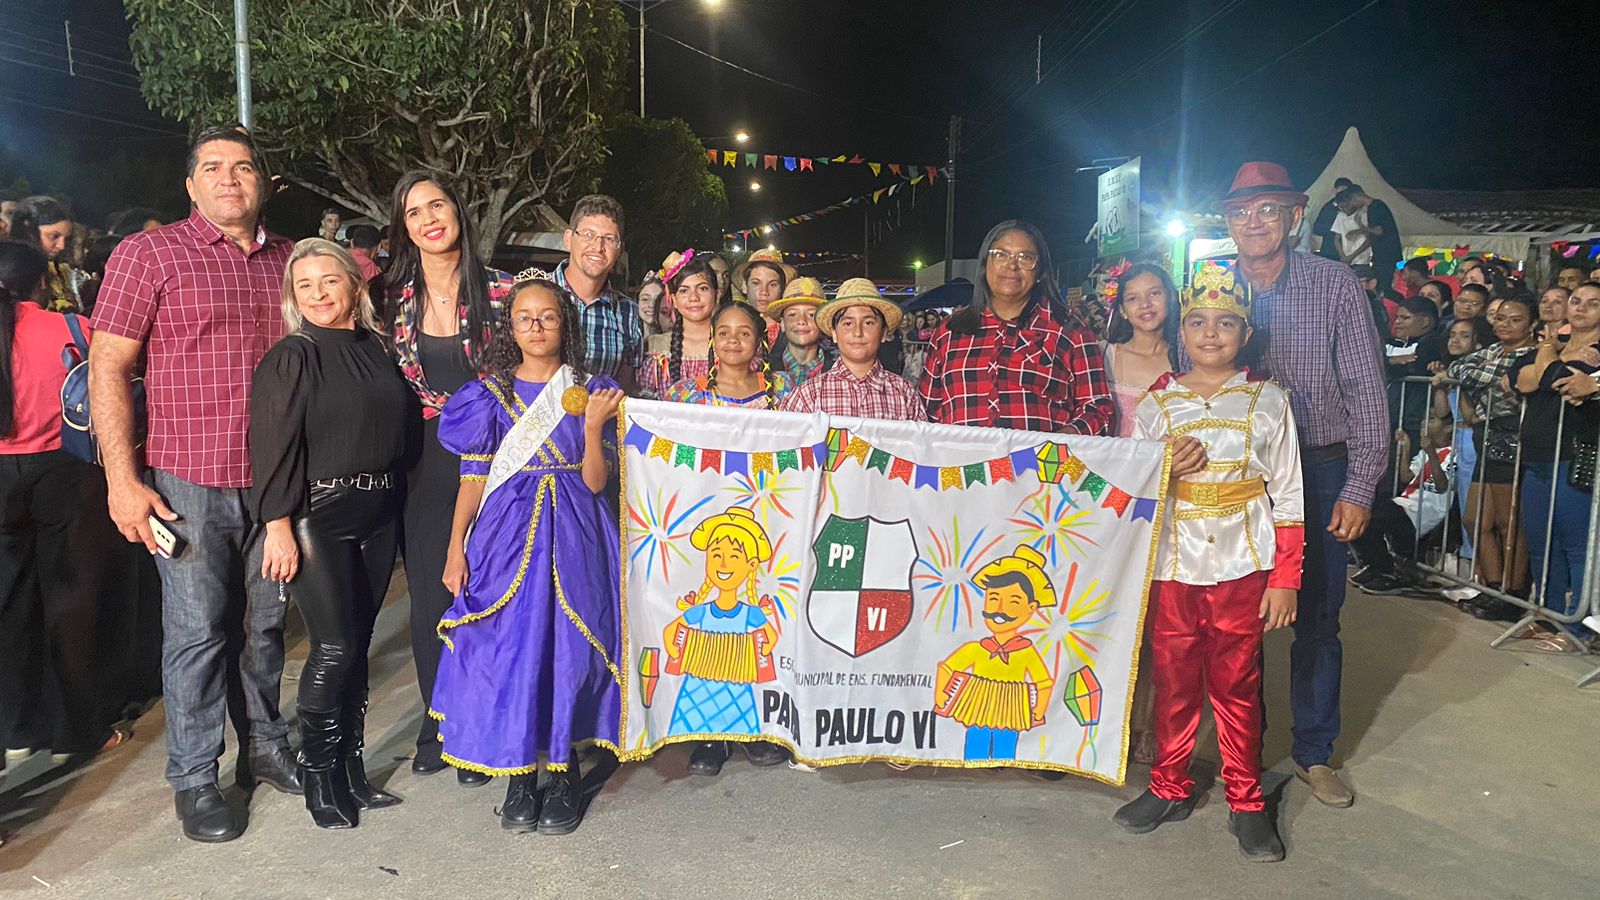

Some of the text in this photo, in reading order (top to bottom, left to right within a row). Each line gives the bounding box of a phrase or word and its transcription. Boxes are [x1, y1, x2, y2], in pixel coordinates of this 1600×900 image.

[828, 543, 855, 568] PP
[867, 607, 887, 631] VI
[794, 671, 834, 687] MUNICIPAL
[836, 672, 846, 686] DE
[848, 673, 867, 686] ENS.
[871, 673, 932, 688] FUNDAMENTAL
[816, 708, 905, 747] PAULO
[912, 710, 937, 749] VI
